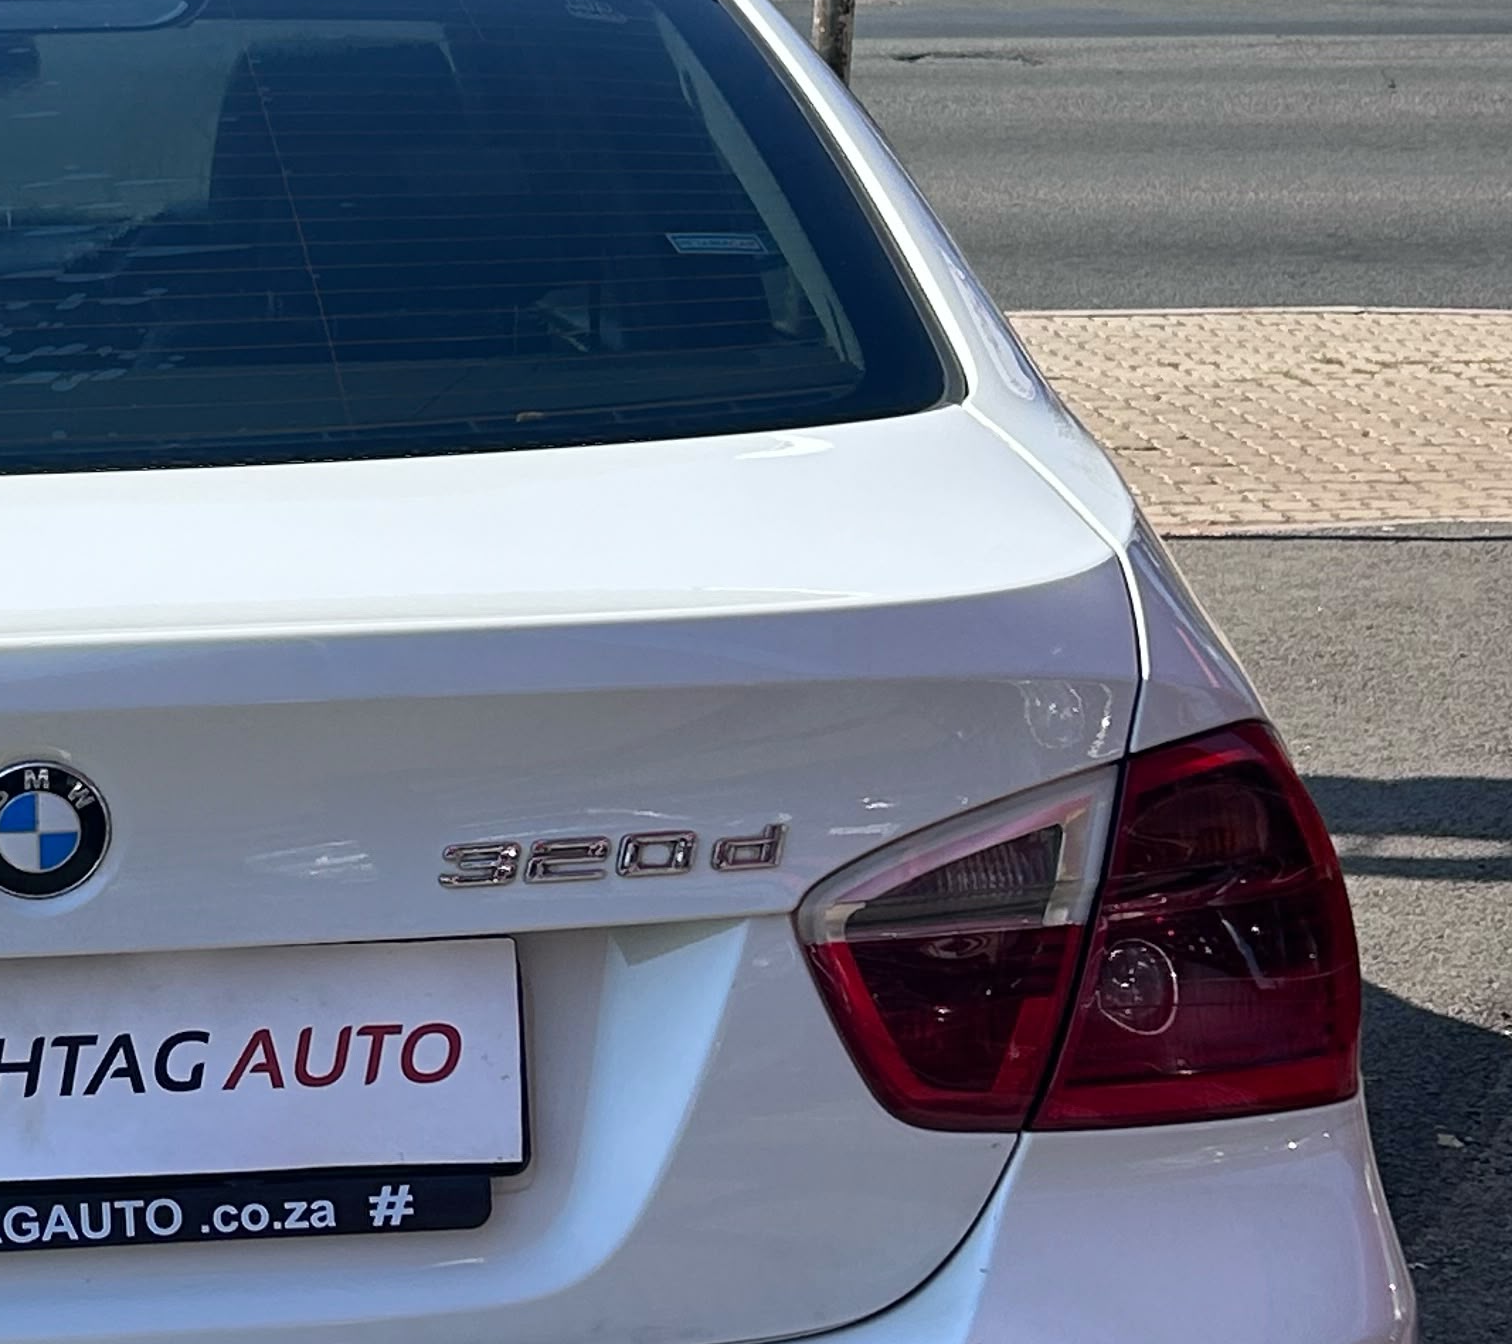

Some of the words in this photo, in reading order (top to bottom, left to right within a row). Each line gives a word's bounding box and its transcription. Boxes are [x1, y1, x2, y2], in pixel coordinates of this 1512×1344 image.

[438, 823, 788, 888] 320d
[221, 1022, 463, 1091] AUTO
[200, 1199, 337, 1235] .co.za
